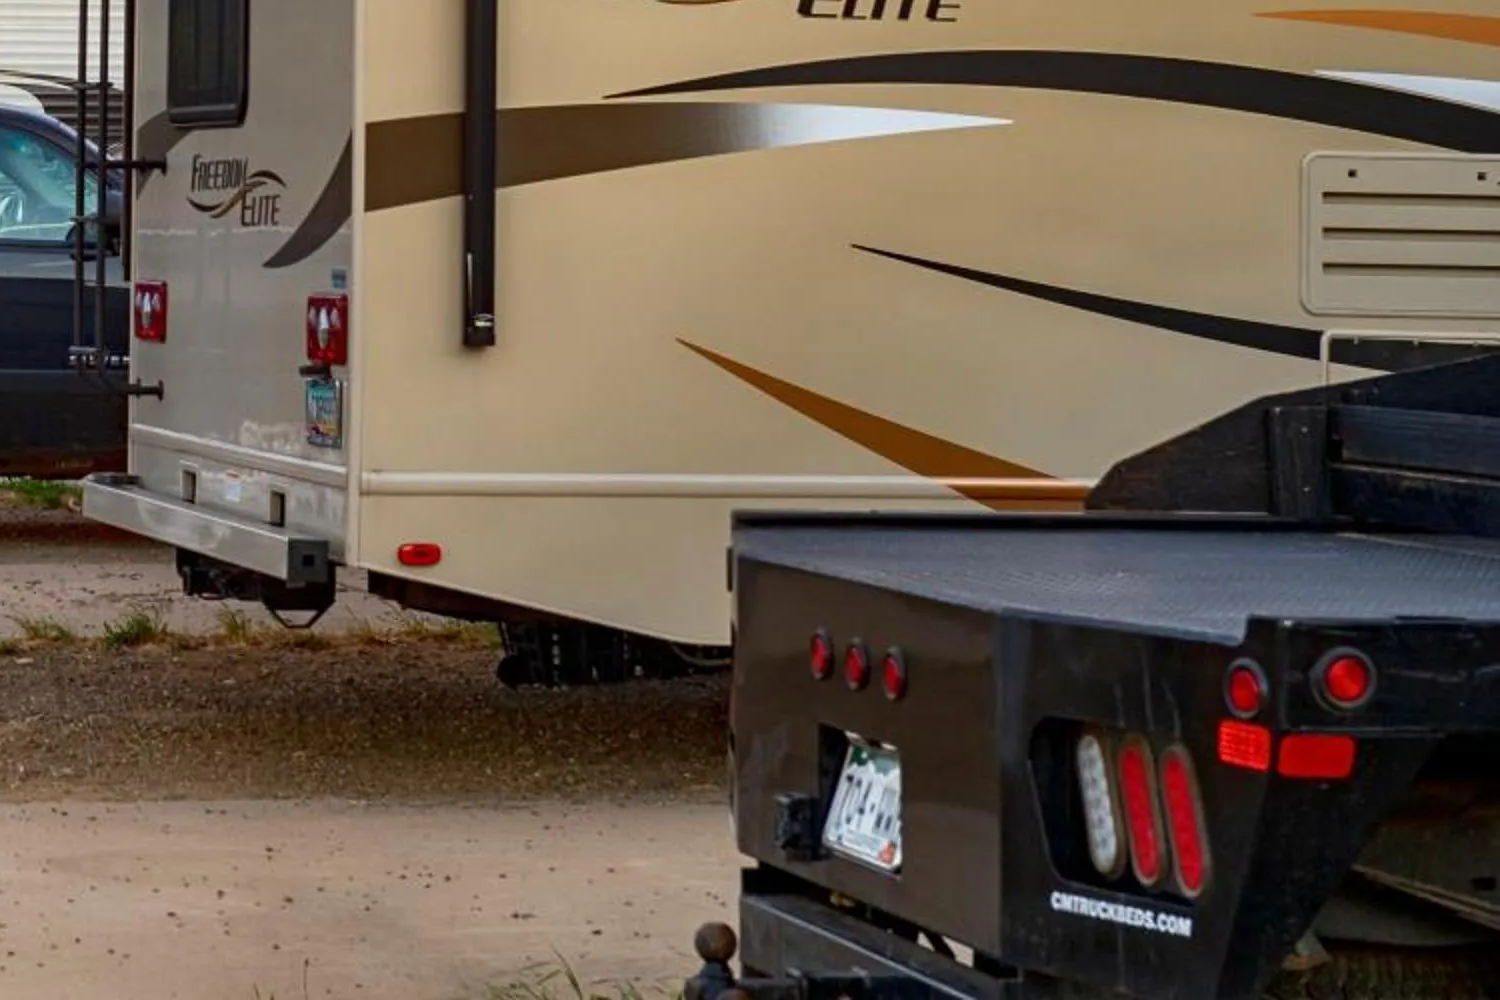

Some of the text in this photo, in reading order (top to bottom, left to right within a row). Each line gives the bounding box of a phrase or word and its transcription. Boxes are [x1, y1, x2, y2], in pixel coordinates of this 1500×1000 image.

[191, 153, 249, 193] FREEDOM
[241, 188, 281, 226] ELITE
[1050, 891, 1193, 937] CMTRUCKBEDS.COM
